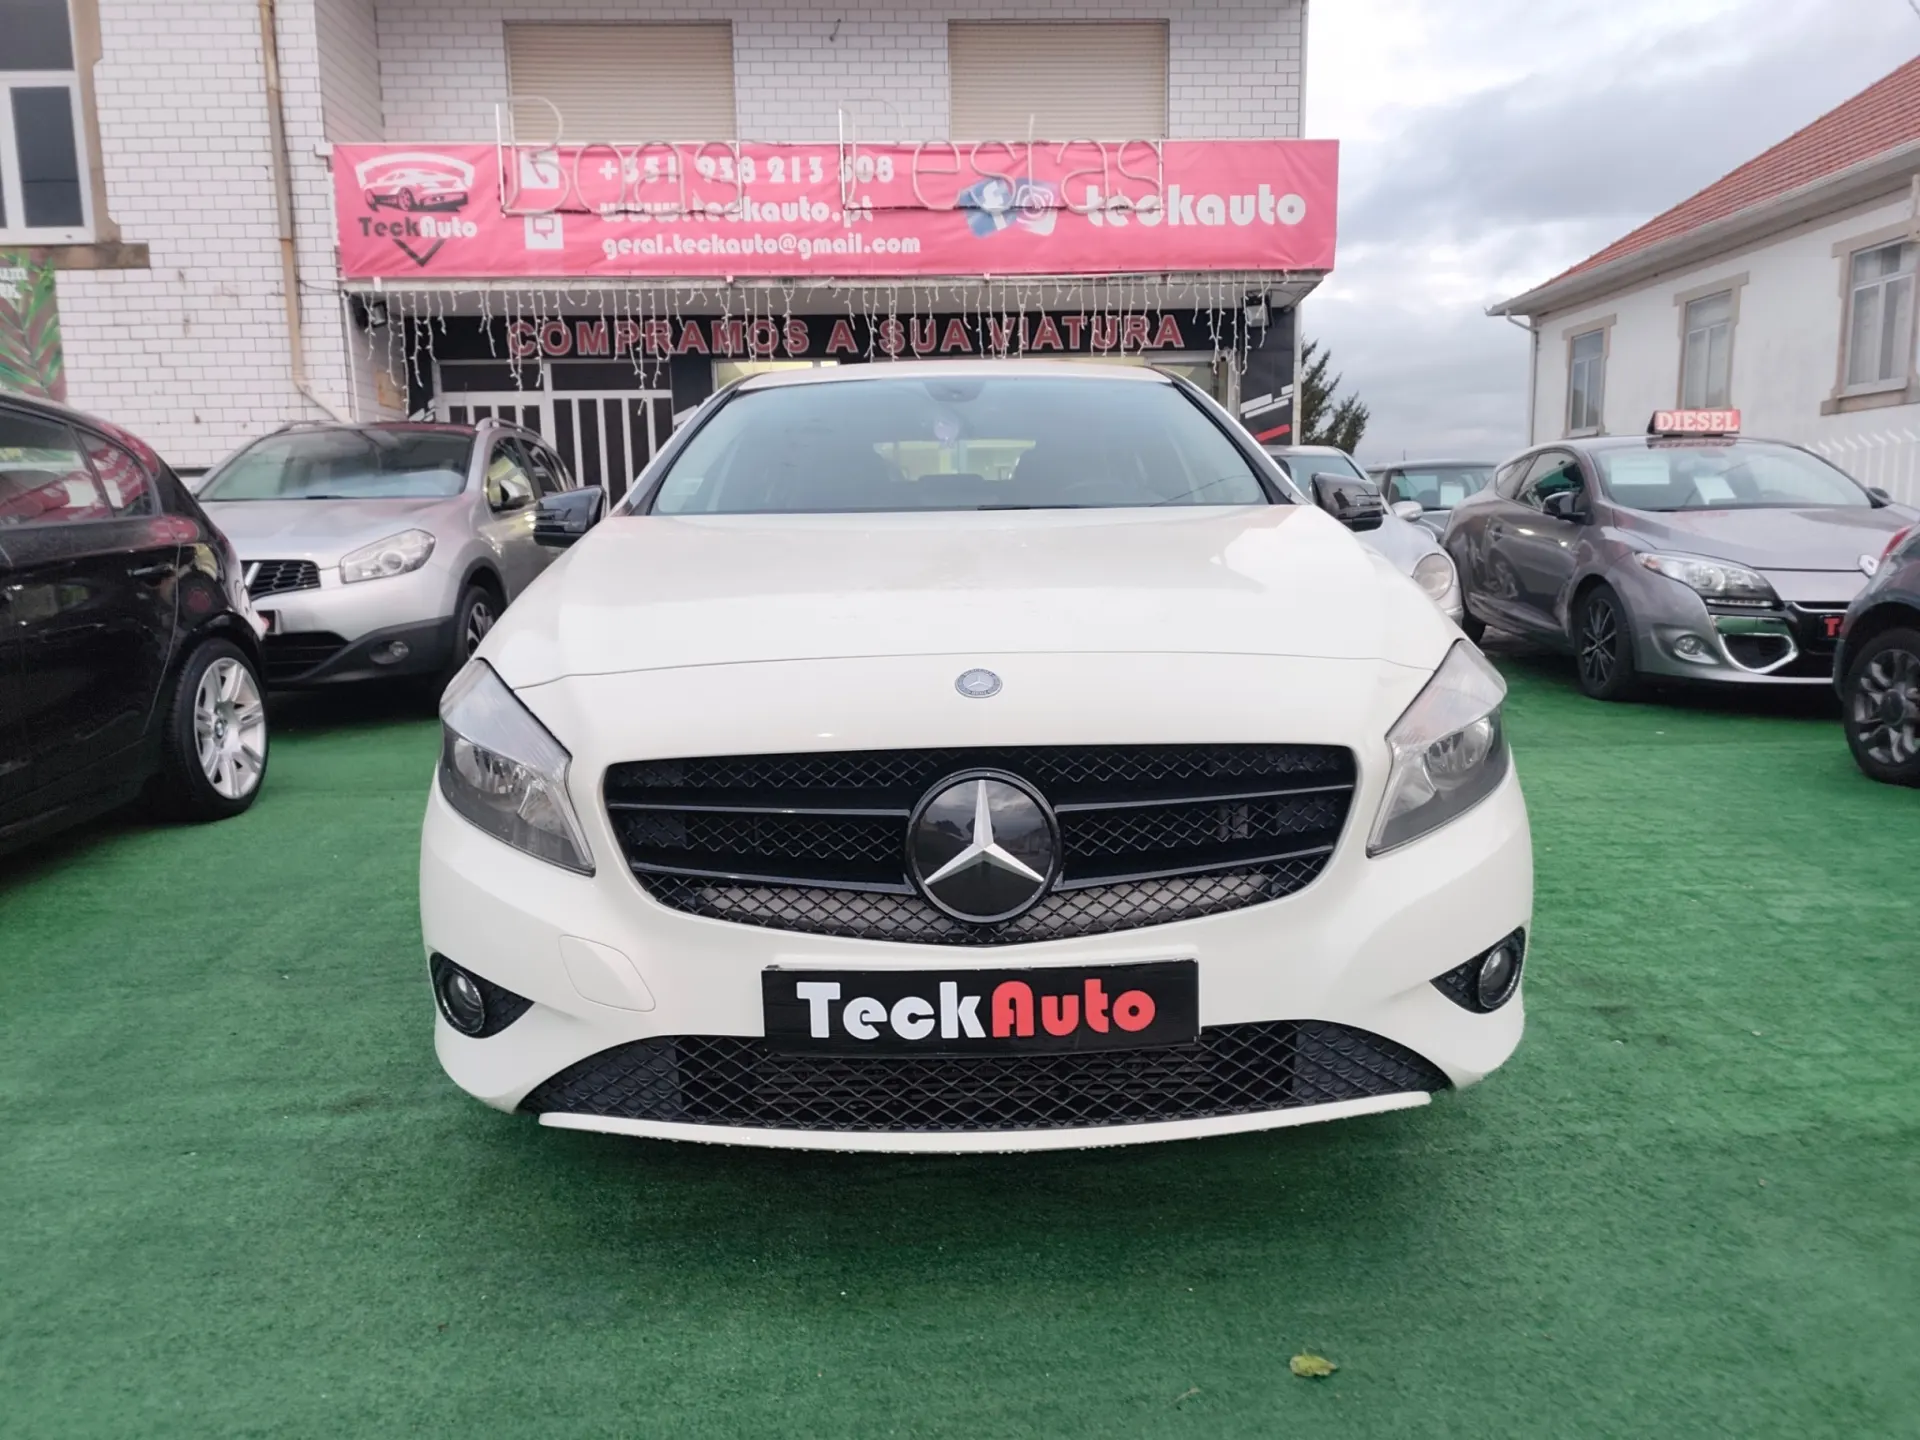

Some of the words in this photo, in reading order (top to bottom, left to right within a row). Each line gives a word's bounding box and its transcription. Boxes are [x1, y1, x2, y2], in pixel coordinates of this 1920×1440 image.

[697, 155, 756, 184] 938
[767, 155, 824, 184] 213
[600, 195, 873, 228] www.teckauto.pt
[1086, 183, 1306, 226] teckauto
[357, 215, 478, 238] TeckAuto
[602, 232, 921, 260] geral.teckauto@gmail.com
[506, 319, 810, 356] COMPRAMOS
[825, 319, 858, 353] A
[878, 316, 973, 352] SUA
[987, 313, 1185, 351] VIATURA
[1656, 411, 1738, 431] DIESEL
[796, 977, 1156, 1040] TeckAuto
